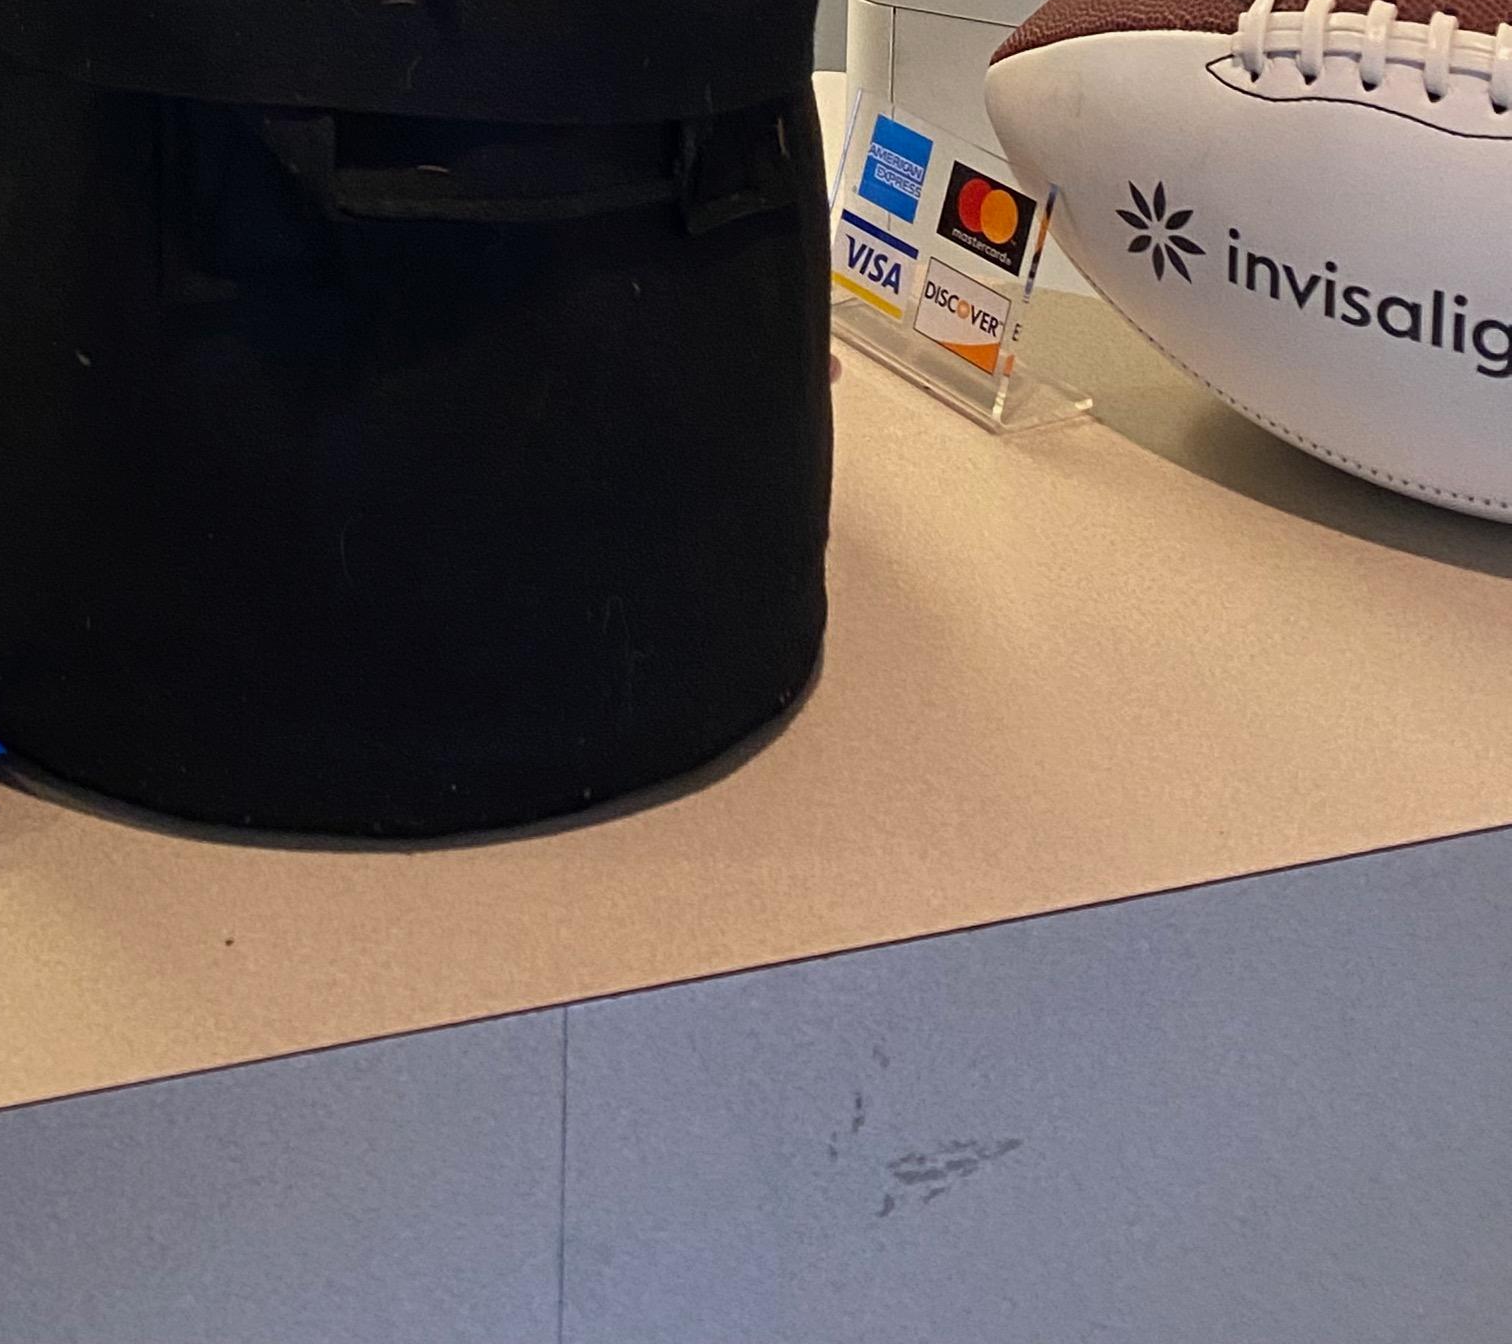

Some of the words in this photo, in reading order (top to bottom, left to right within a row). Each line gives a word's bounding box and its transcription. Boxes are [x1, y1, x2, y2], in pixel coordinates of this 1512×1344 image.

[868, 143, 924, 179] AMERICAN
[875, 165, 921, 198] EXPRESS
[846, 234, 902, 294] VISA
[925, 281, 999, 337] DISCOVER
